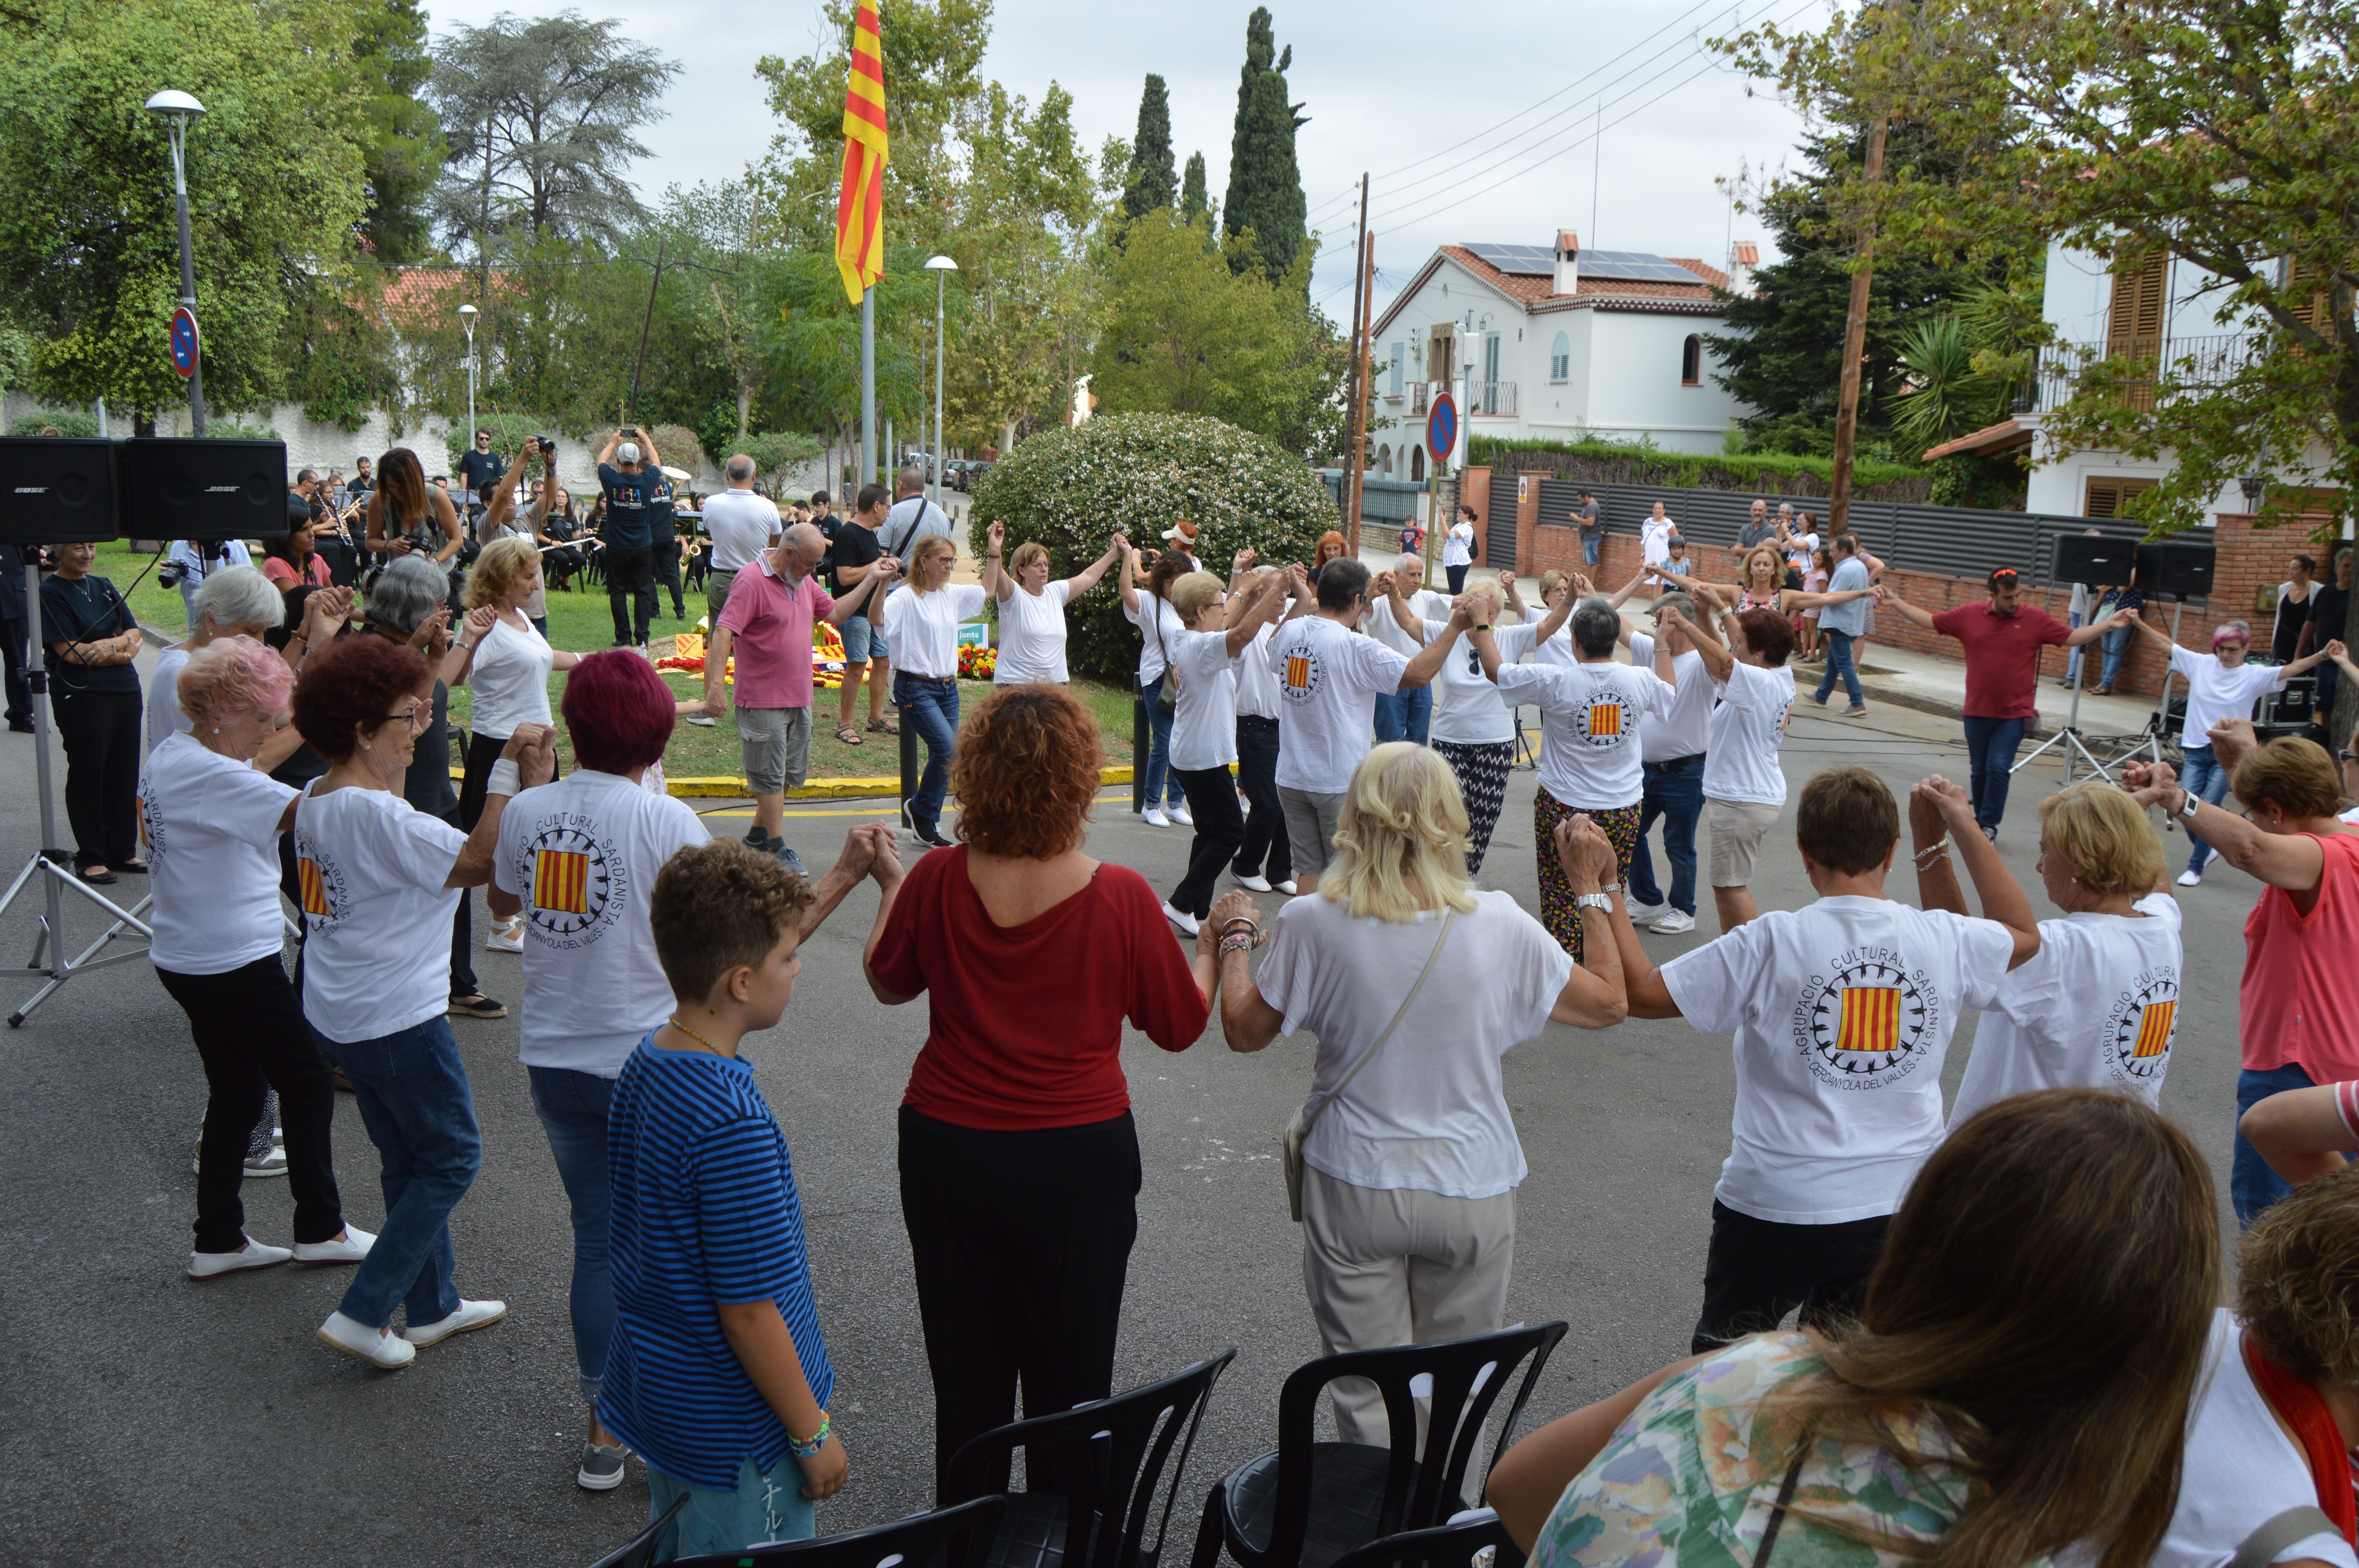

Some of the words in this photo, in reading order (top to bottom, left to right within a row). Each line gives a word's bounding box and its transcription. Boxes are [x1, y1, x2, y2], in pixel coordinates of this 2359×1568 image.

[682, 640, 698, 656] CERDANYOLA
[959, 631, 979, 640] junts
[1316, 652, 1326, 694] SARDANISTA
[1568, 701, 1582, 738] AGRUPACIÓ
[1586, 685, 1622, 698] CULTURAL
[149, 788, 165, 858] SARDANISTA
[536, 813, 598, 835] CULTURAL
[603, 839, 626, 926] SARDANISTA
[526, 923, 562, 950] RDANYOLA
[564, 941, 581, 950] DEL
[580, 927, 603, 946] VALLÈS
[1794, 975, 1824, 1056] AGRUPACIÓ
[1831, 947, 1904, 969] CULTURAL
[1912, 970, 1938, 1056] SARDANISTA
[2103, 991, 2131, 1065] AGRUPACIÓ
[1809, 1062, 1861, 1090] CERDANYOLA
[1864, 1079, 1882, 1089] DEL
[1883, 1061, 1916, 1085] VALLÈS
